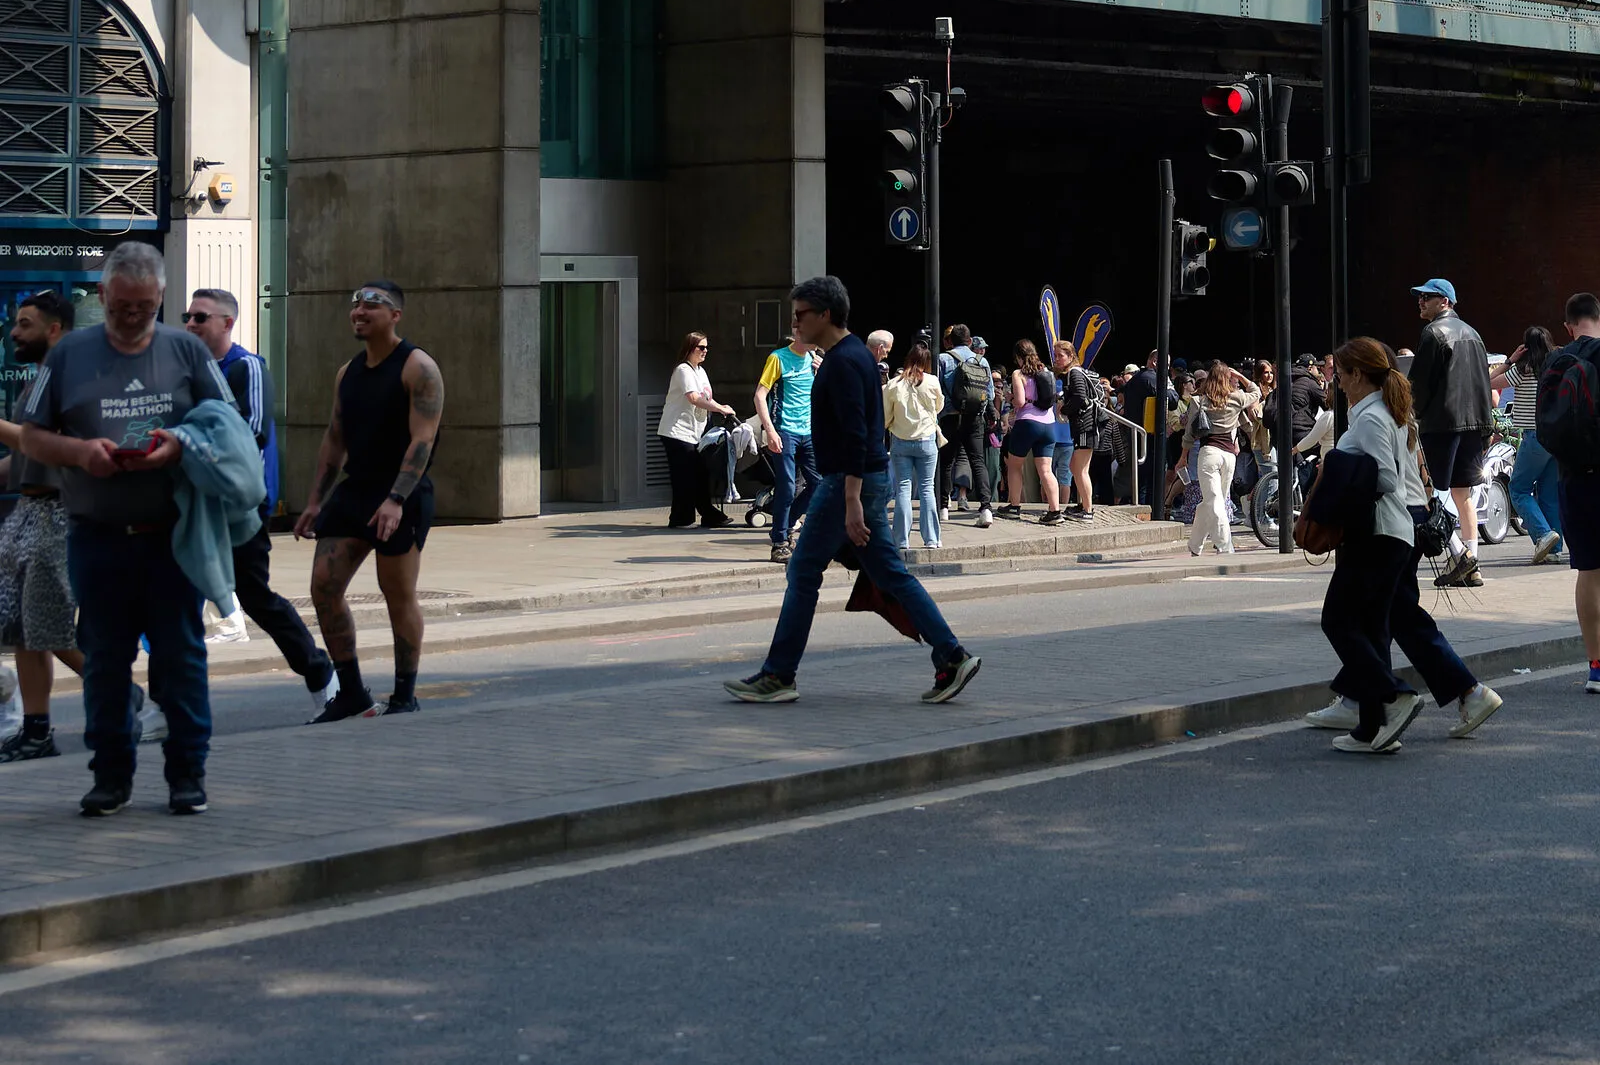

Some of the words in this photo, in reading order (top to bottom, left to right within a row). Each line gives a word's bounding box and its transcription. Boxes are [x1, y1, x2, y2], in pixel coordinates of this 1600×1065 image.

[15, 245, 73, 256] WATERSPORTS
[77, 246, 104, 256] STORE
[101, 398, 129, 408] BMW
[130, 393, 172, 406] BERLIN
[101, 403, 173, 418] MARATHON
